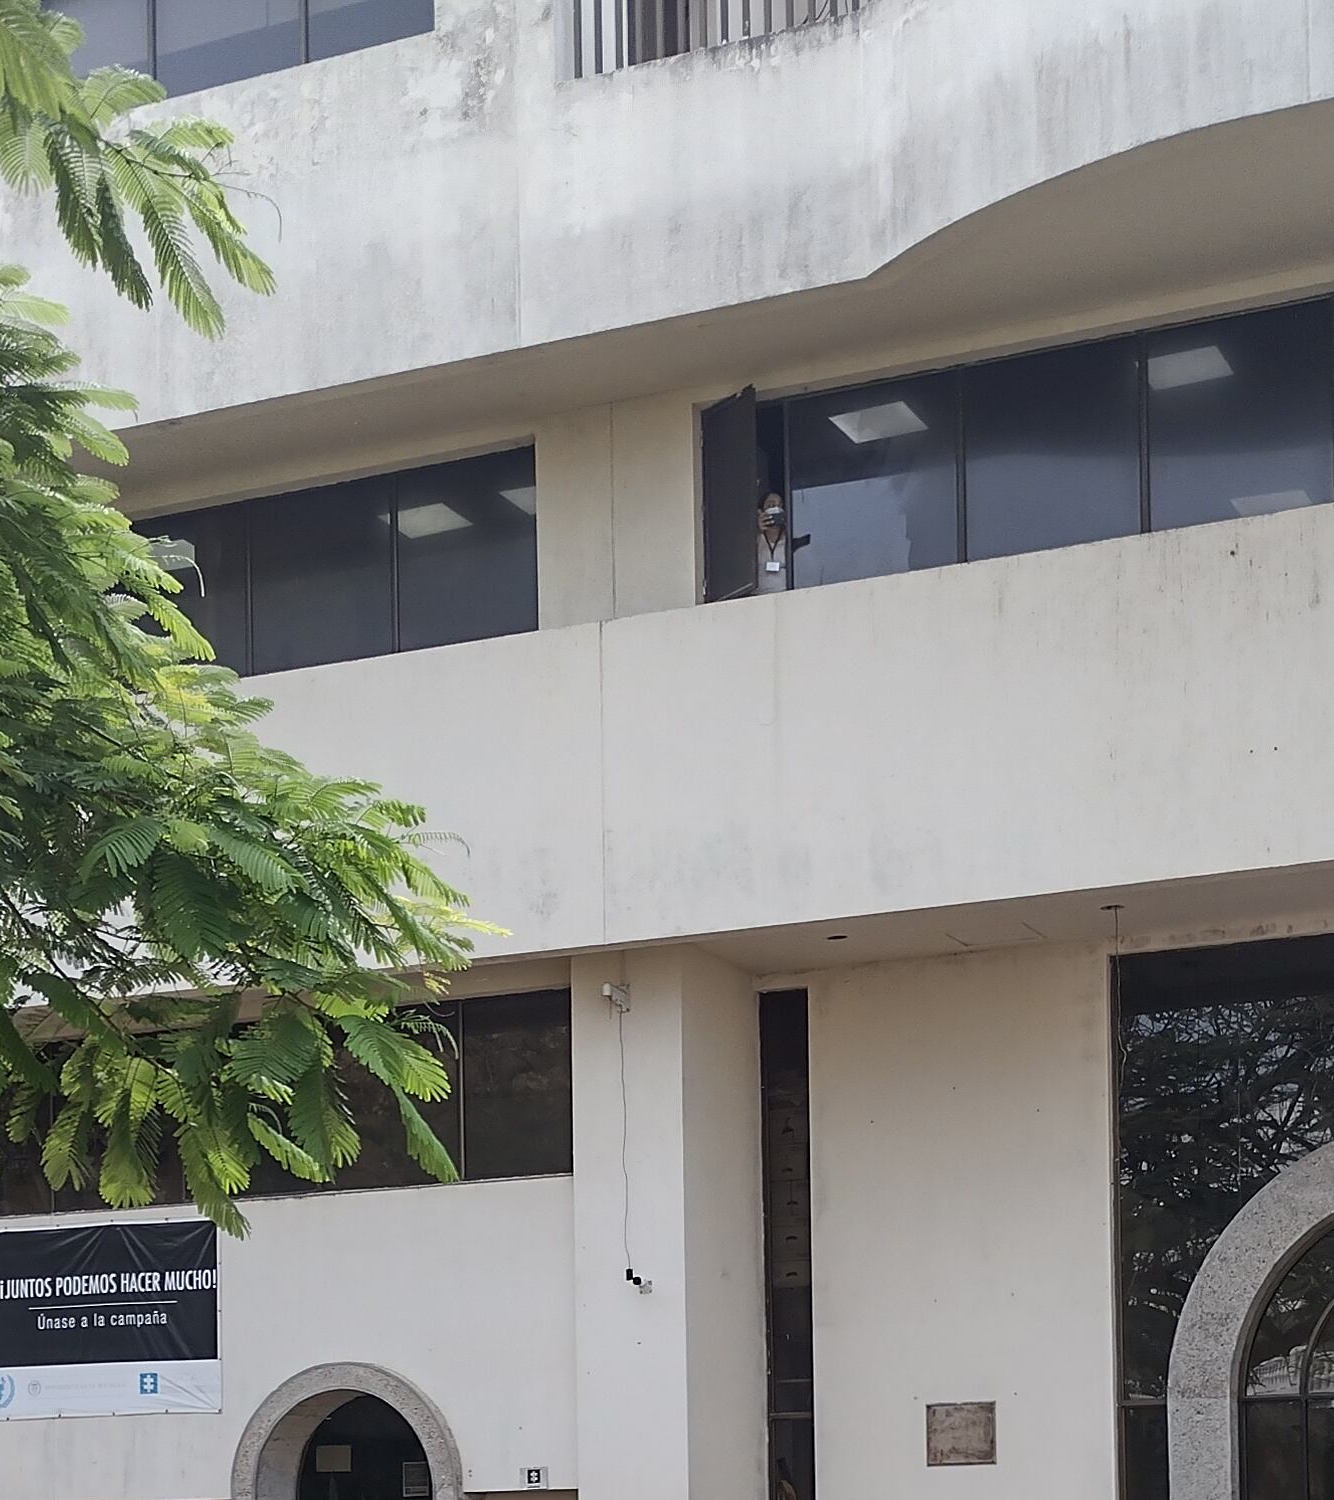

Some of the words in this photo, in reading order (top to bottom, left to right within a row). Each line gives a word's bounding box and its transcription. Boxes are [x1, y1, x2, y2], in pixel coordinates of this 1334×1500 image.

[0, 1277, 53, 1300] ¡JUNTOS
[55, 1273, 117, 1297] PODEMOS
[120, 1271, 161, 1293] HACER
[164, 1269, 216, 1291] MUCHO!
[37, 1313, 76, 1330] Únase
[80, 1316, 88, 1328] a
[93, 1312, 106, 1327] la
[110, 1310, 168, 1328] campaña
